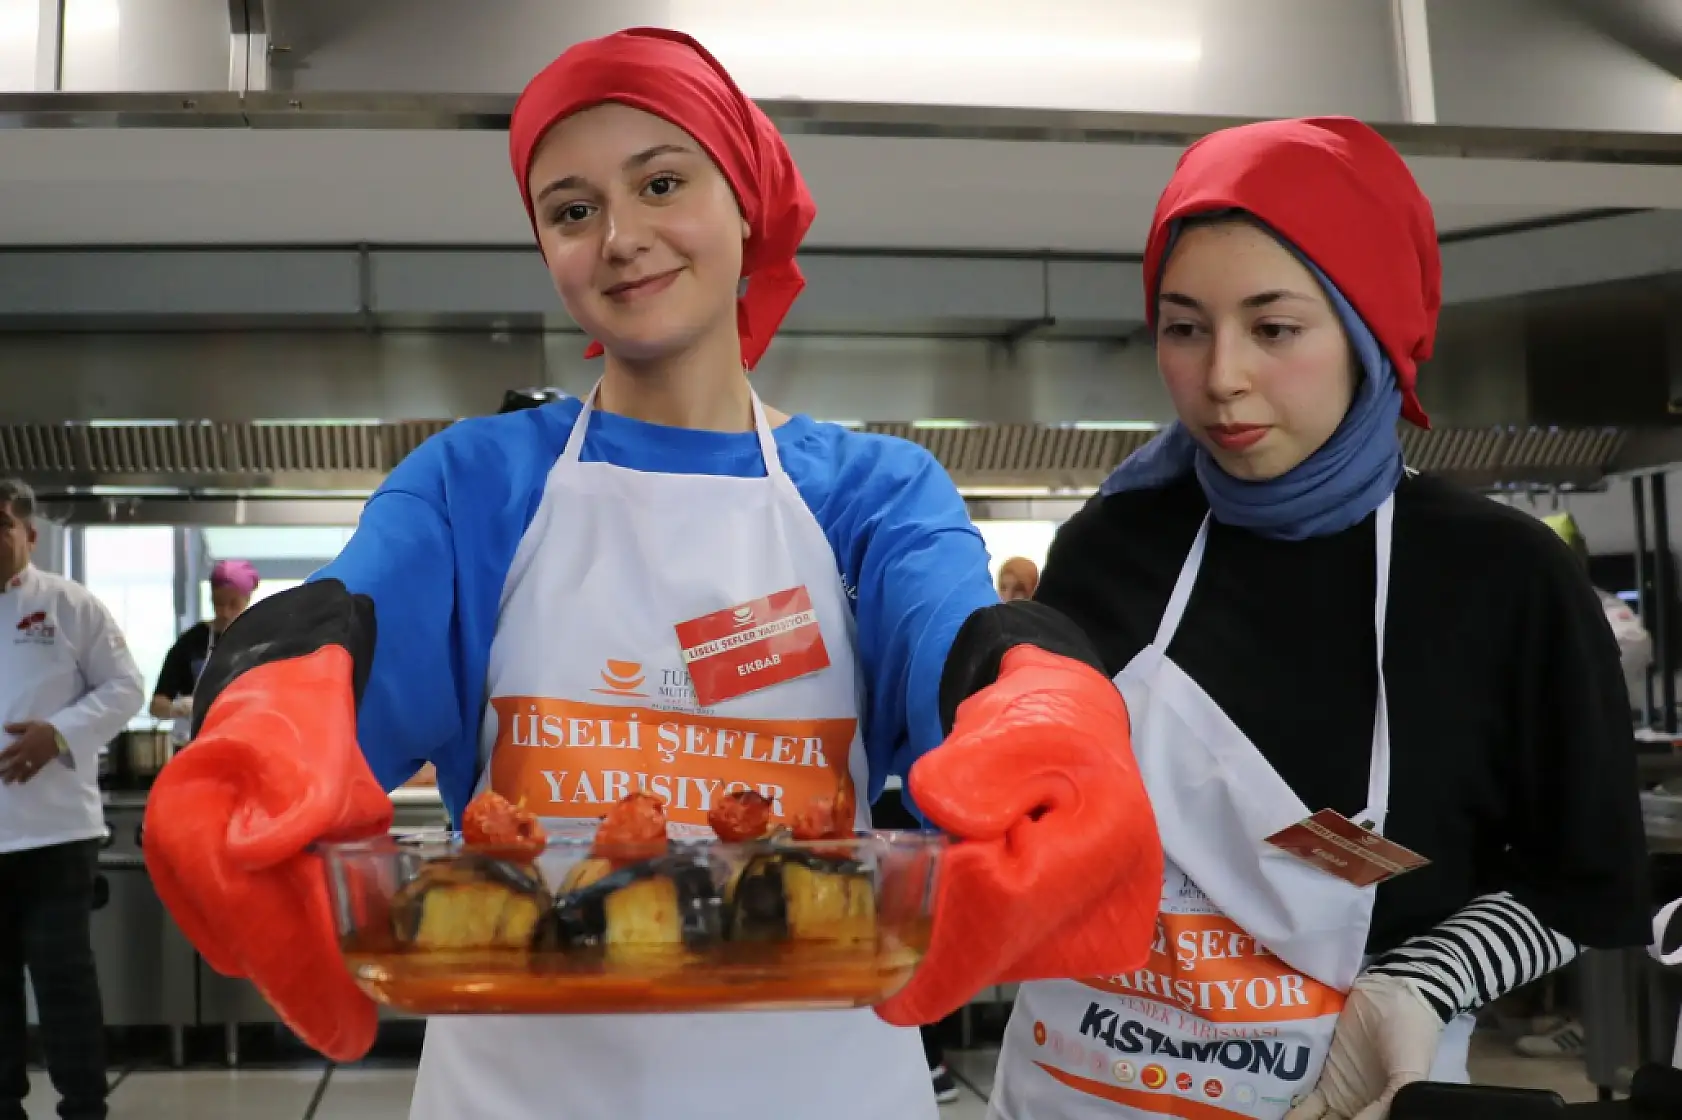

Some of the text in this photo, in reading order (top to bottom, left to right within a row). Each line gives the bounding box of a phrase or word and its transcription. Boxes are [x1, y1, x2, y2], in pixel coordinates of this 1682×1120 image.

[737, 654, 781, 677] EKBAB
[512, 704, 828, 767] LİSELİ ŞEFLER
[541, 770, 785, 817] YARIŞIYR
[1098, 968, 1309, 1012] ARIŞIYOR
[1080, 1001, 1310, 1081] KASTAMONU
